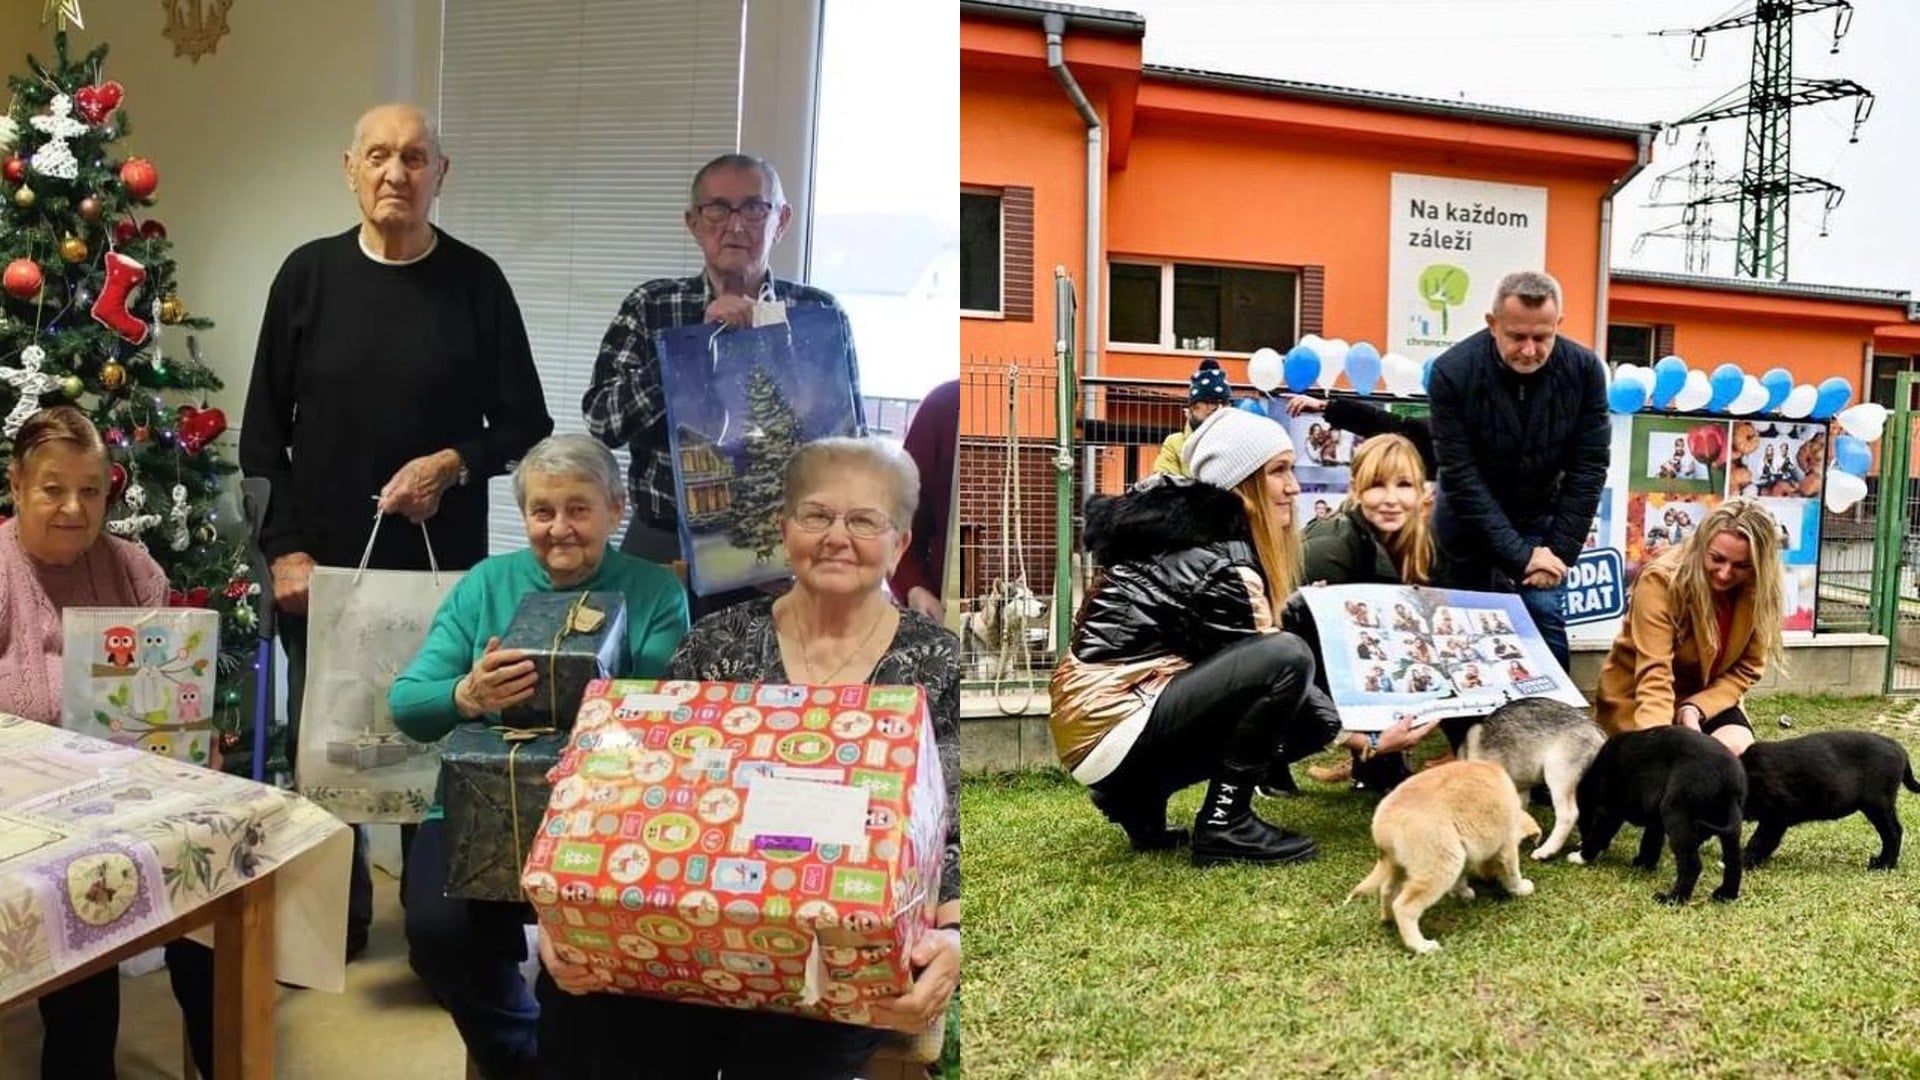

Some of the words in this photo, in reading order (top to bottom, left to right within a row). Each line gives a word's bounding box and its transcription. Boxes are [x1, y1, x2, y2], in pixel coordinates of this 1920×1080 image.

[1410, 199, 1439, 220] Na
[1446, 202, 1528, 228] každom
[1409, 227, 1472, 251] záleží
[1567, 560, 1614, 589] ODA
